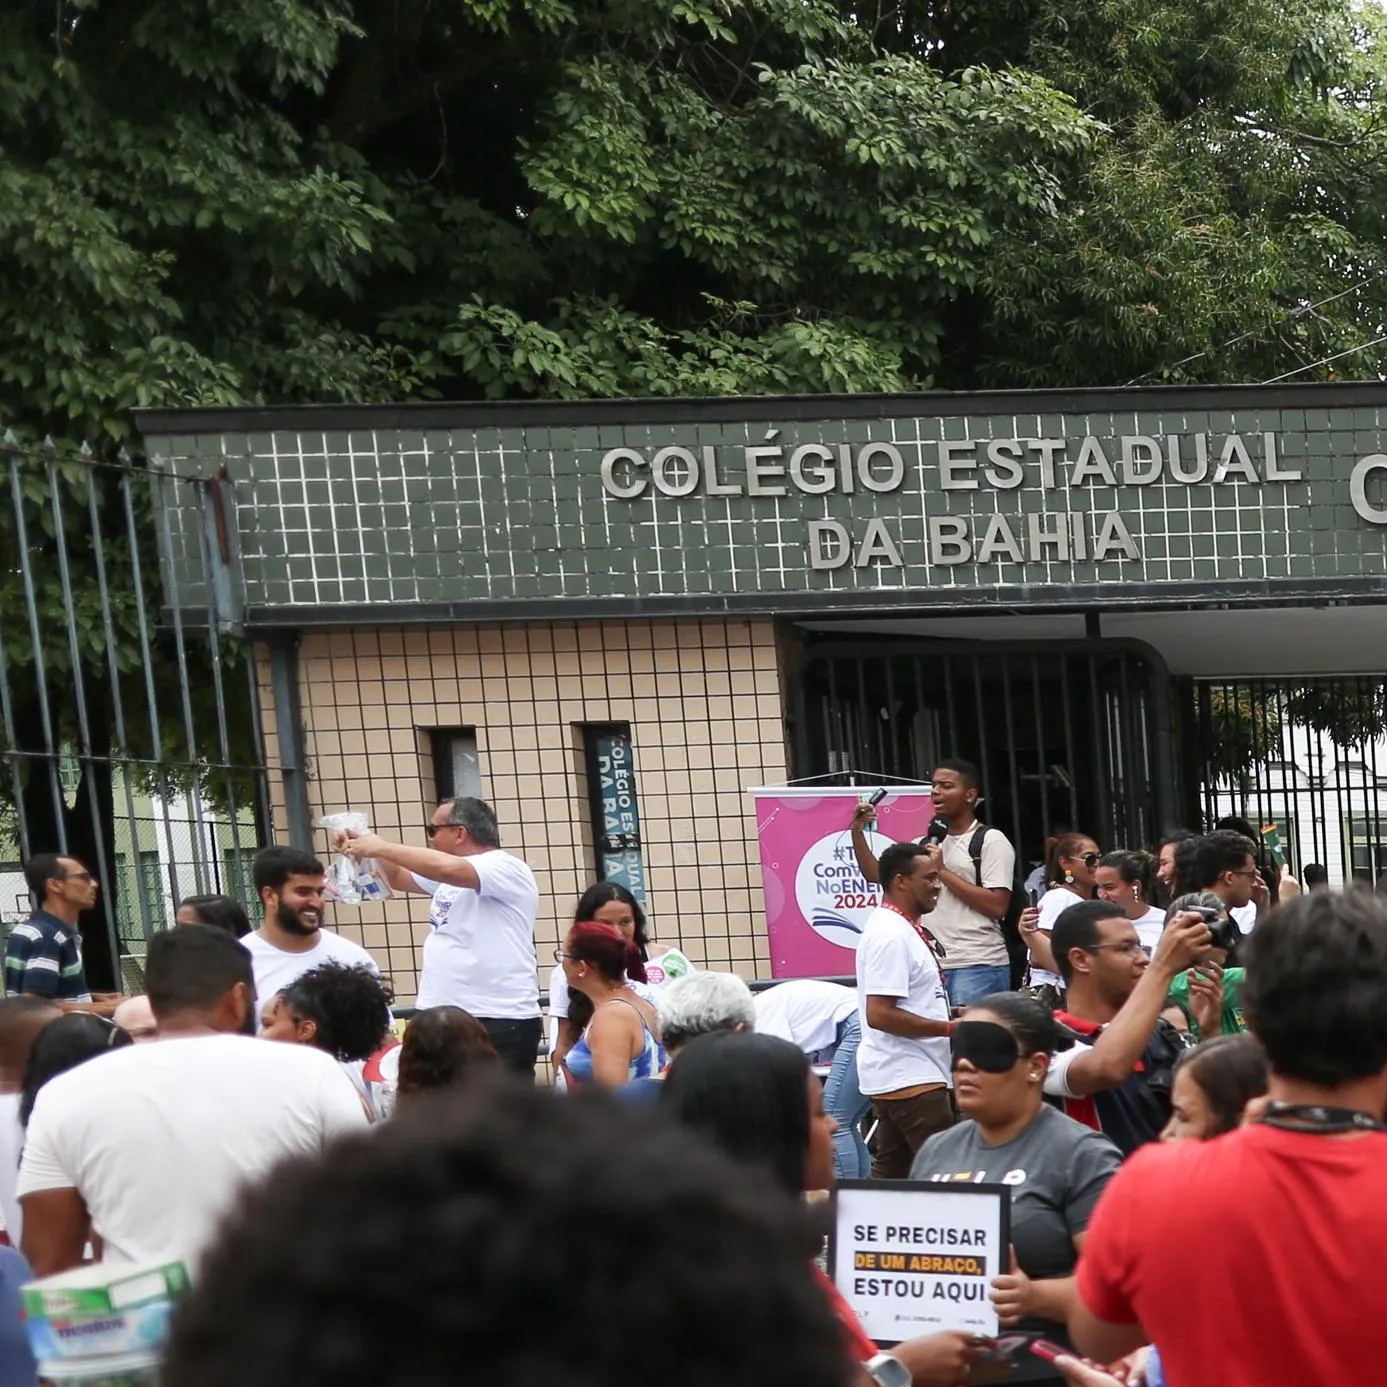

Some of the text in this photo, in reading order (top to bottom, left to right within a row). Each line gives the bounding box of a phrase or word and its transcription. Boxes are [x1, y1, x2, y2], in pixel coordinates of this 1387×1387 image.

[601, 428, 1302, 498] COLÉGIO ESTADUAL
[808, 510, 1142, 571] DA BAHIA
[834, 894, 878, 909] 2024
[854, 1224, 987, 1247] SE PRECISAR
[855, 1253, 982, 1275] DE UM ABRAÇO,
[854, 1278, 985, 1303] ESTOU AQUI
